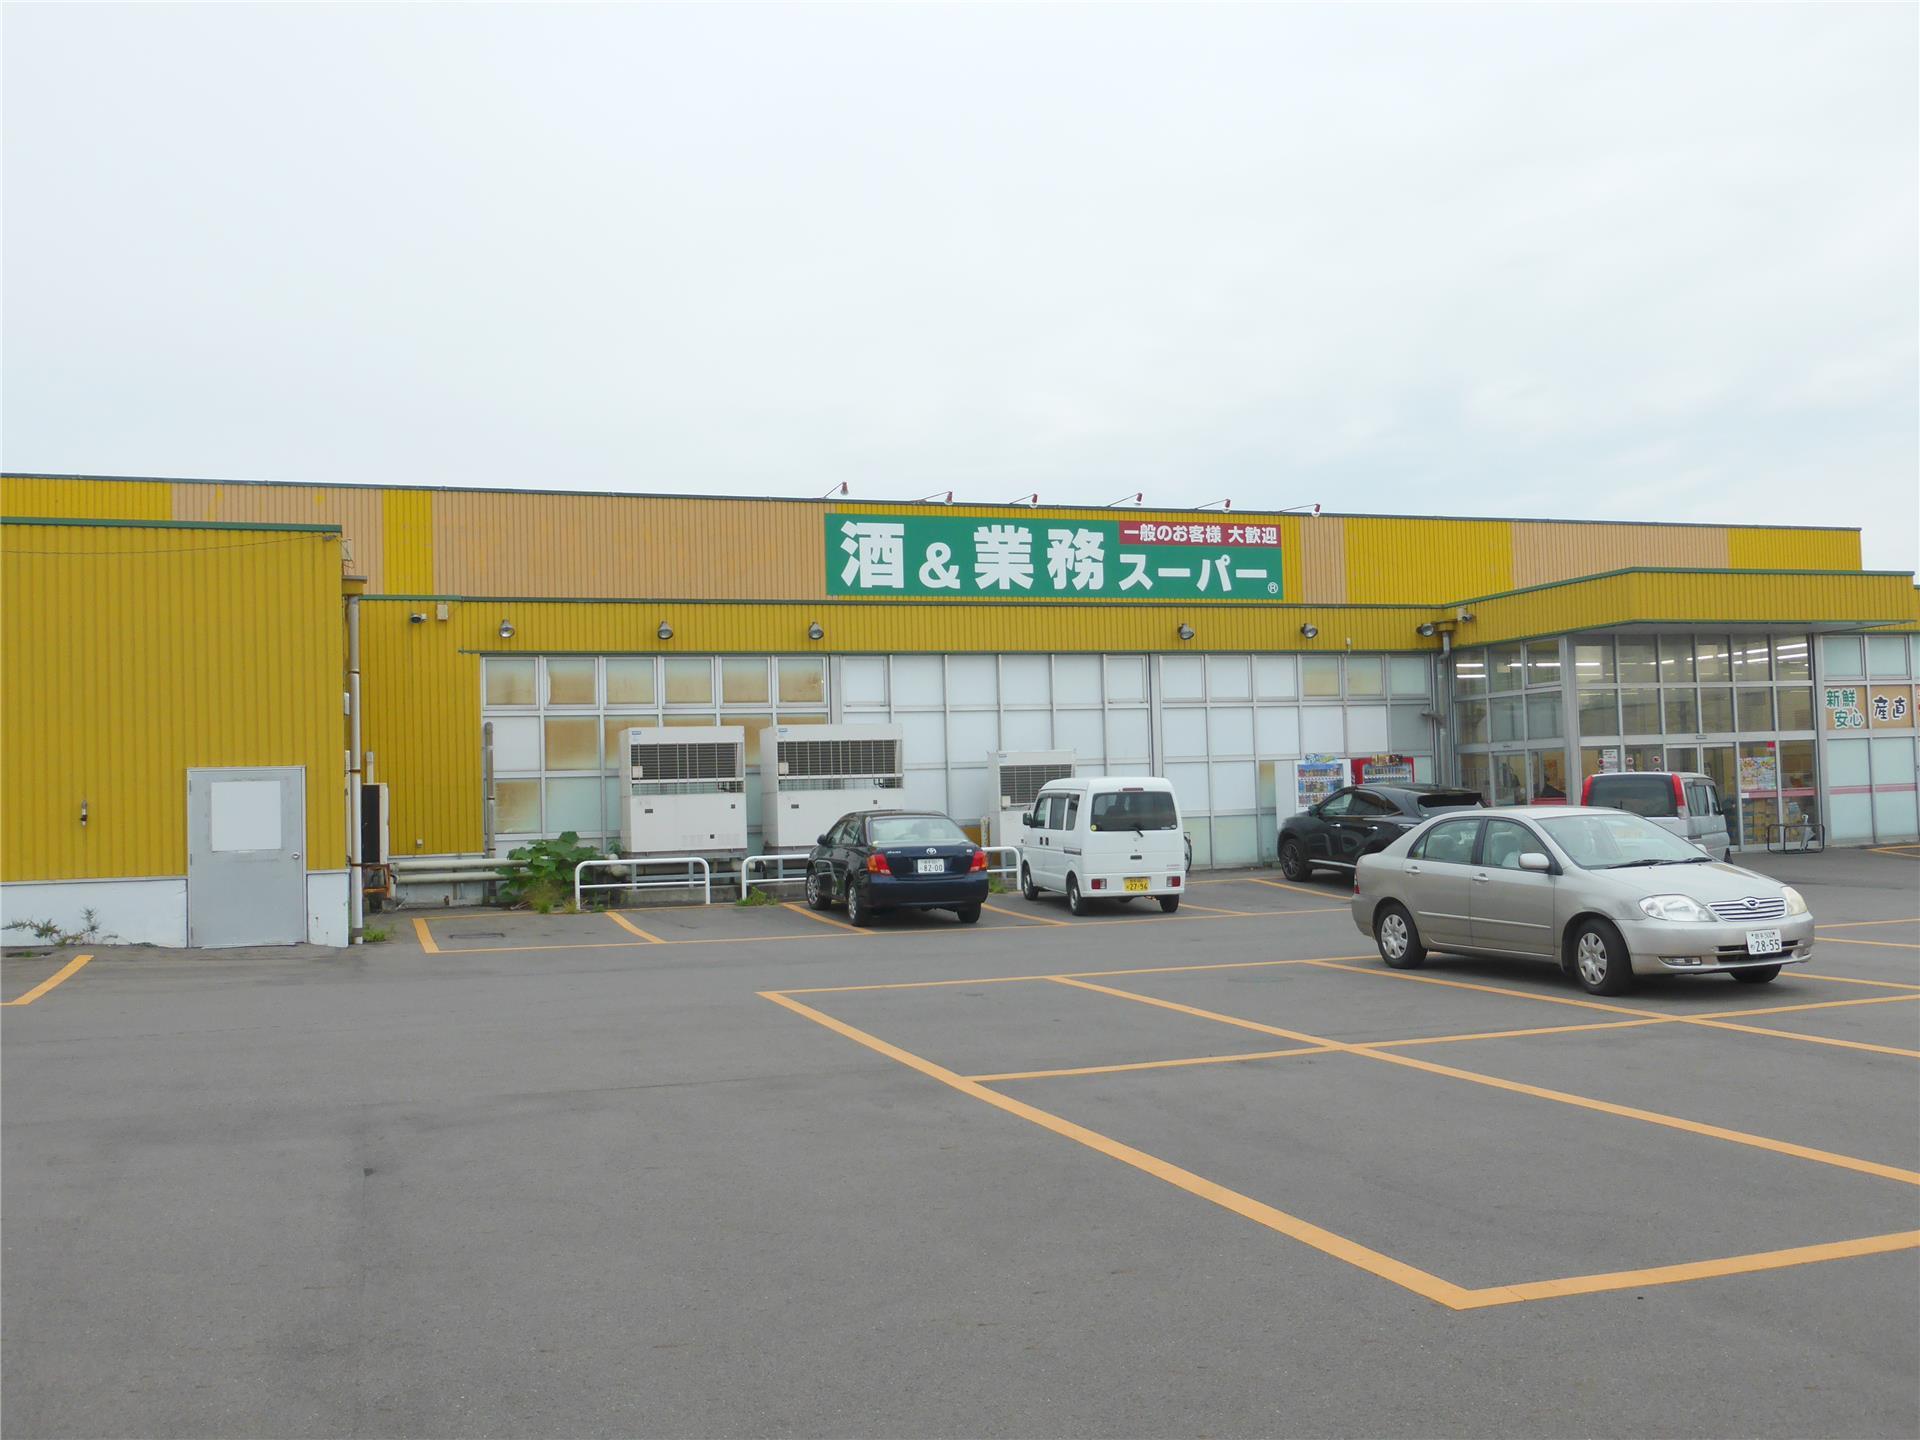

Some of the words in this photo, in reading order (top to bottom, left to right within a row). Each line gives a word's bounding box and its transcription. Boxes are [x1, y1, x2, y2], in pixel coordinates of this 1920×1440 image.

[1124, 523, 1222, 544] 一般のお客様
[1228, 525, 1278, 545] 大歓迎
[1826, 688, 1856, 707] 新鮮
[1835, 708, 1864, 728] 安心
[1874, 696, 1906, 720] 産直
[1756, 939, 1780, 952] 28-55
